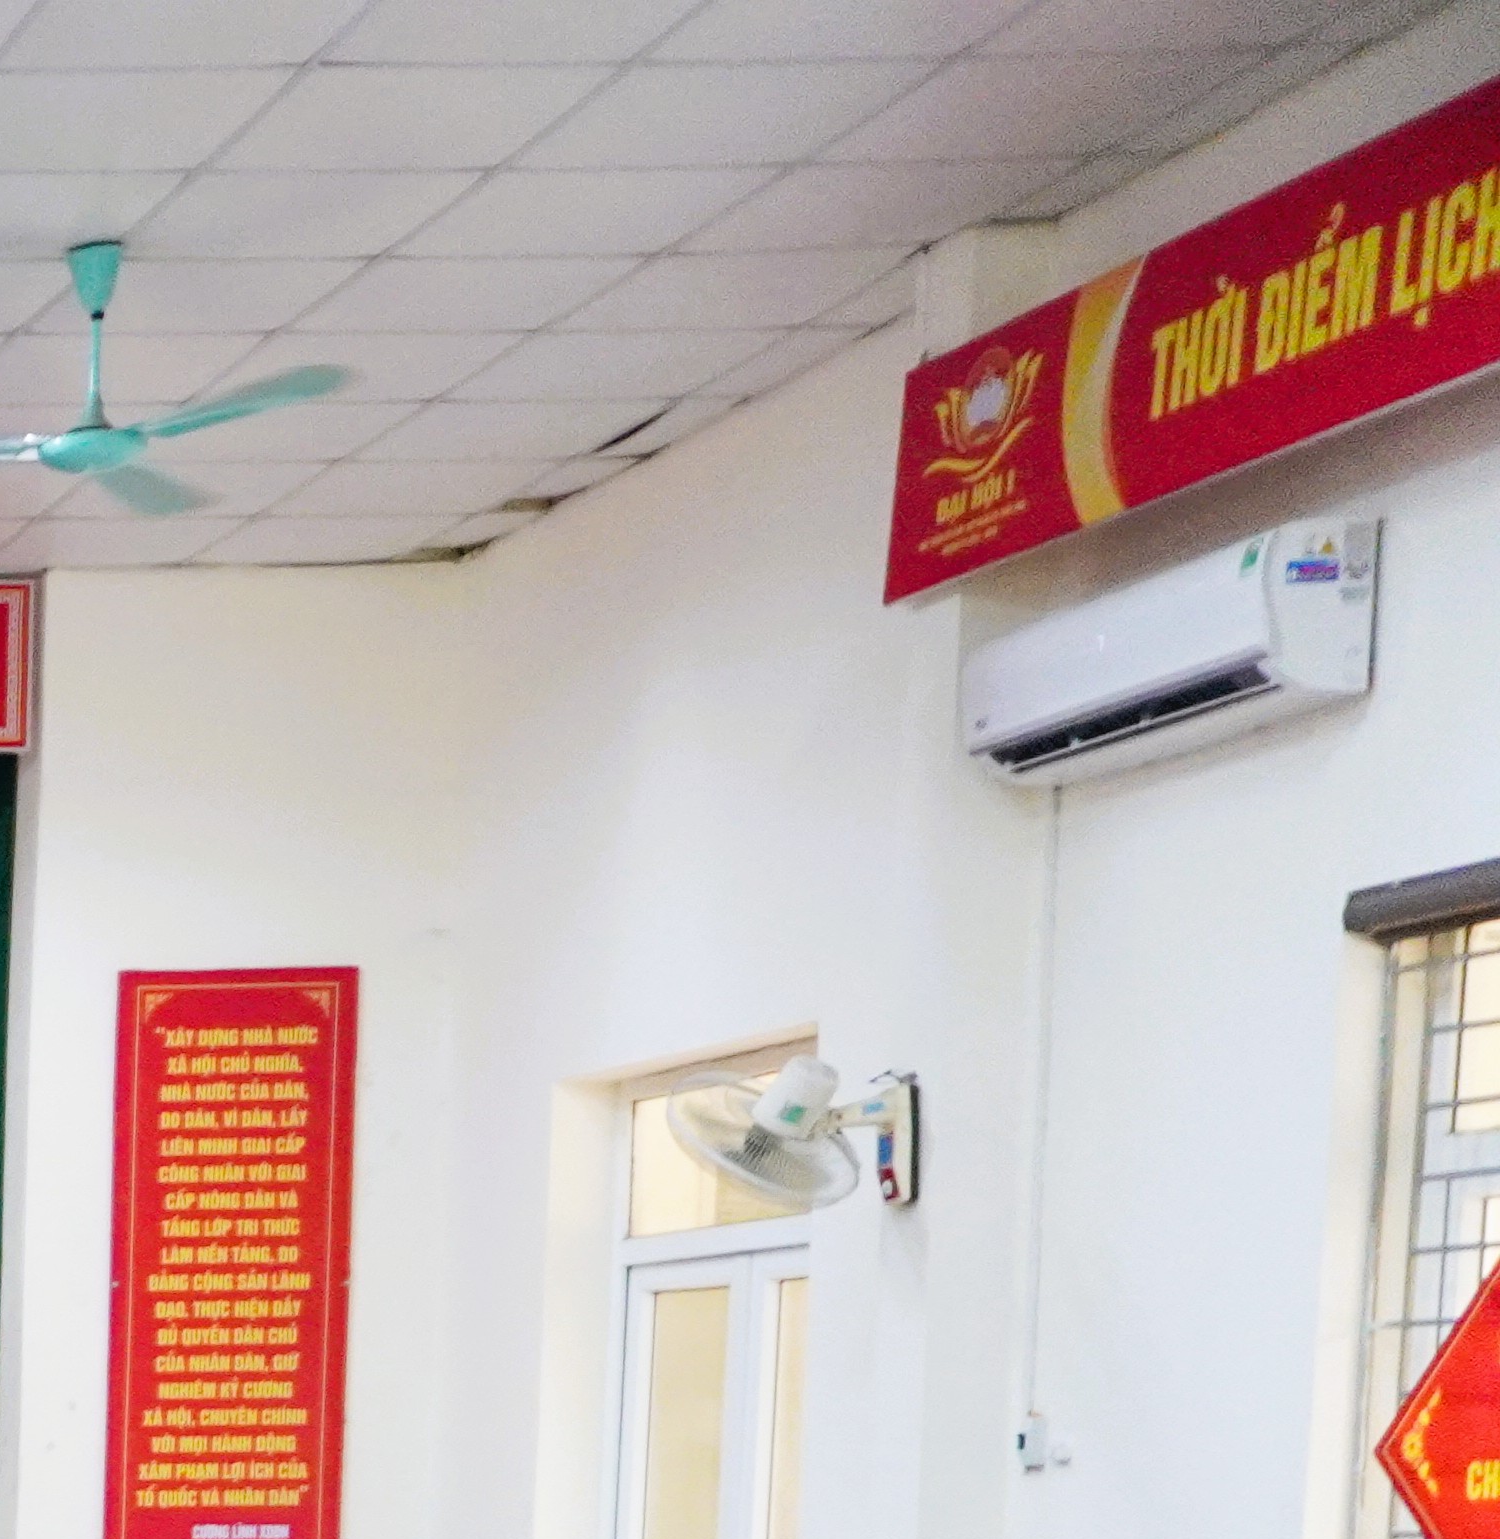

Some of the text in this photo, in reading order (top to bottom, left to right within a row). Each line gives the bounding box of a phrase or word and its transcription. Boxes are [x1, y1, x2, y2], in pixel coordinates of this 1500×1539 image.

[1149, 169, 1500, 421] THỜI ĐIỂM LỊCH
